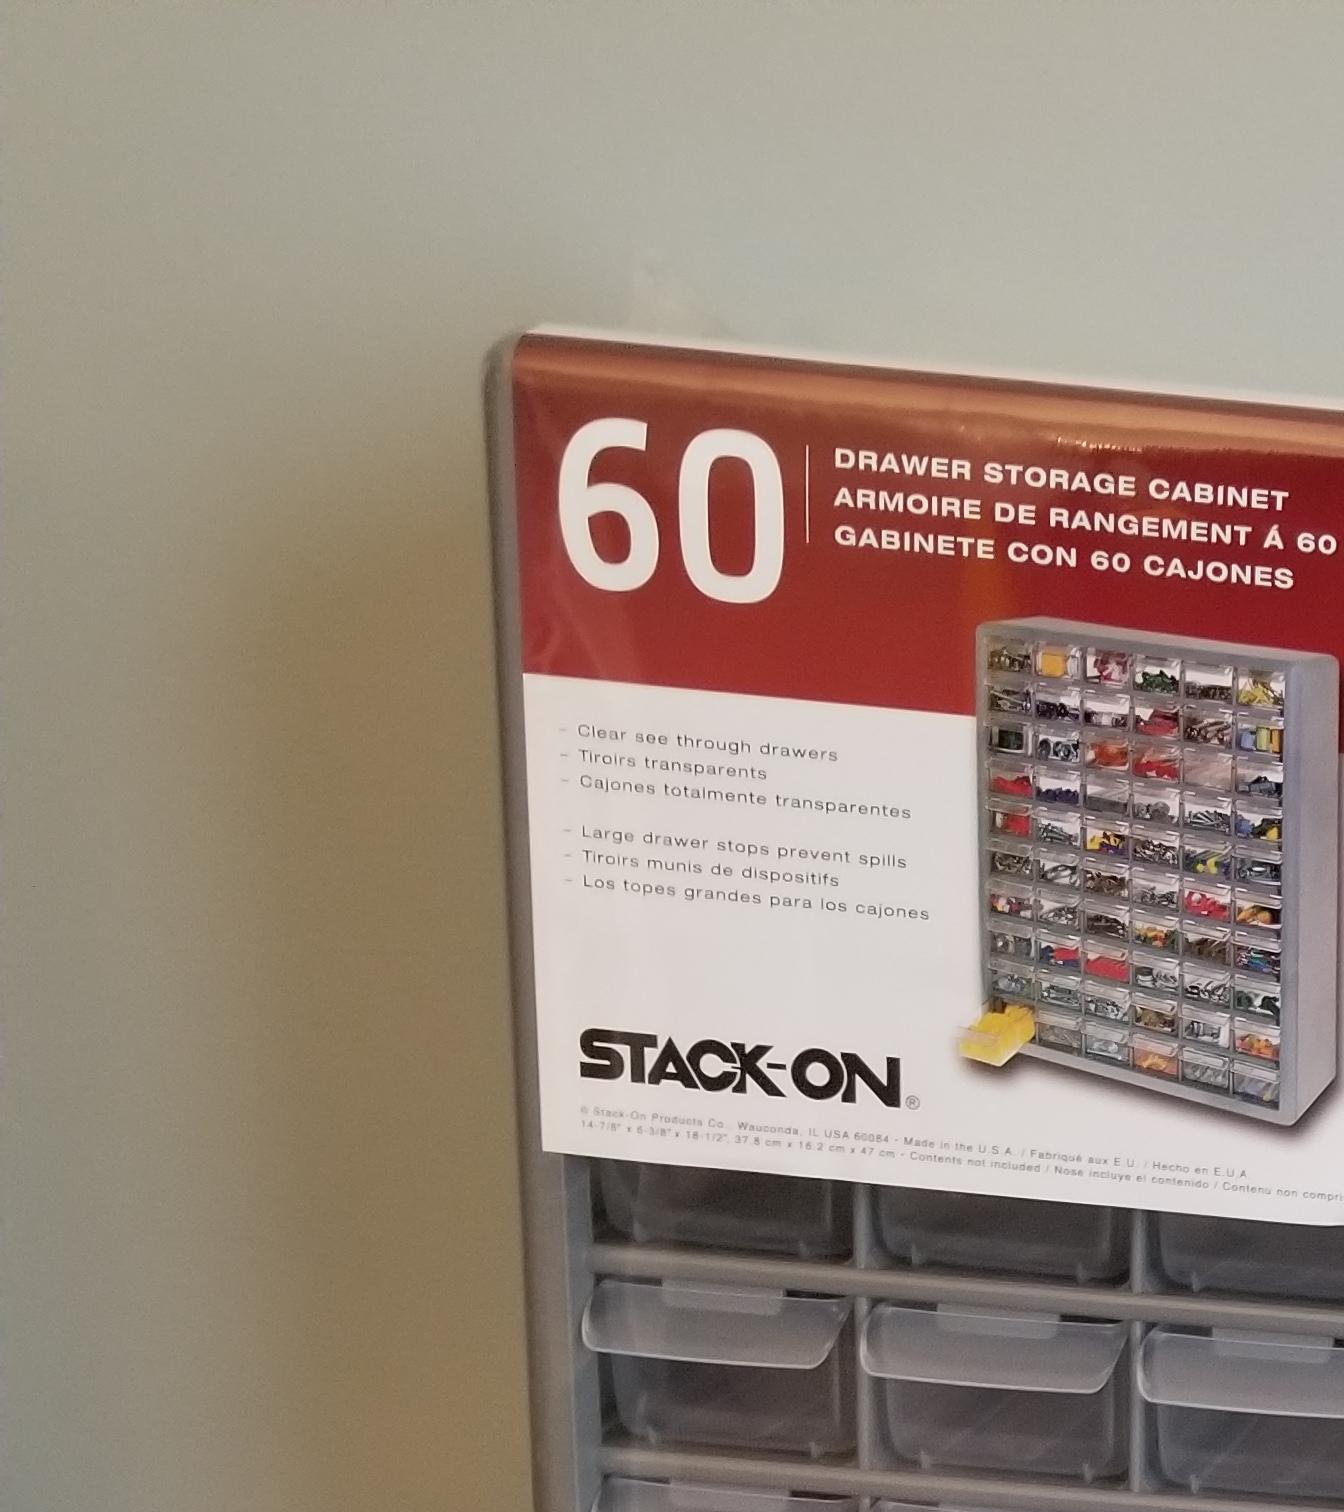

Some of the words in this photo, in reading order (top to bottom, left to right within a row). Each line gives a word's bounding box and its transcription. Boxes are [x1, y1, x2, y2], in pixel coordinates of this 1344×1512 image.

[835, 448, 971, 480] DRAWER
[983, 463, 1136, 496] STORAGE
[1148, 479, 1289, 510] CABINET
[558, 416, 785, 604] 60
[834, 488, 981, 519] ARMOIRE
[994, 502, 1036, 525] DE
[1049, 508, 1252, 545] RANGEMENT
[1297, 532, 1337, 555] 60
[834, 526, 995, 559] GABINETE
[1007, 542, 1077, 567] CON
[1090, 550, 1131, 573] 60
[1143, 555, 1294, 589] CAJONES
[577, 724, 627, 741] Clear
[635, 732, 668, 746] see
[676, 734, 751, 756] through
[759, 743, 838, 762] drawers
[578, 748, 636, 768] Tiroirs
[644, 757, 767, 780] transparents
[579, 774, 656, 795] Cajones
[664, 784, 767, 805] totalmente
[775, 795, 911, 819] transparentes
[581, 849, 639, 868] Tiroirs
[647, 859, 703, 874] munis
[710, 863, 733, 877] de
[741, 866, 839, 887] dispositifs
[582, 825, 634, 845] Large
[642, 831, 709, 849] drawer
[716, 840, 770, 857] stops
[777, 846, 851, 864] prevent
[858, 854, 907, 869] spills
[583, 874, 615, 891] Los
[623, 879, 676, 897] topes
[684, 887, 762, 904] grandes
[769, 895, 813, 909] para
[820, 897, 848, 913] los
[855, 903, 930, 921] cajones
